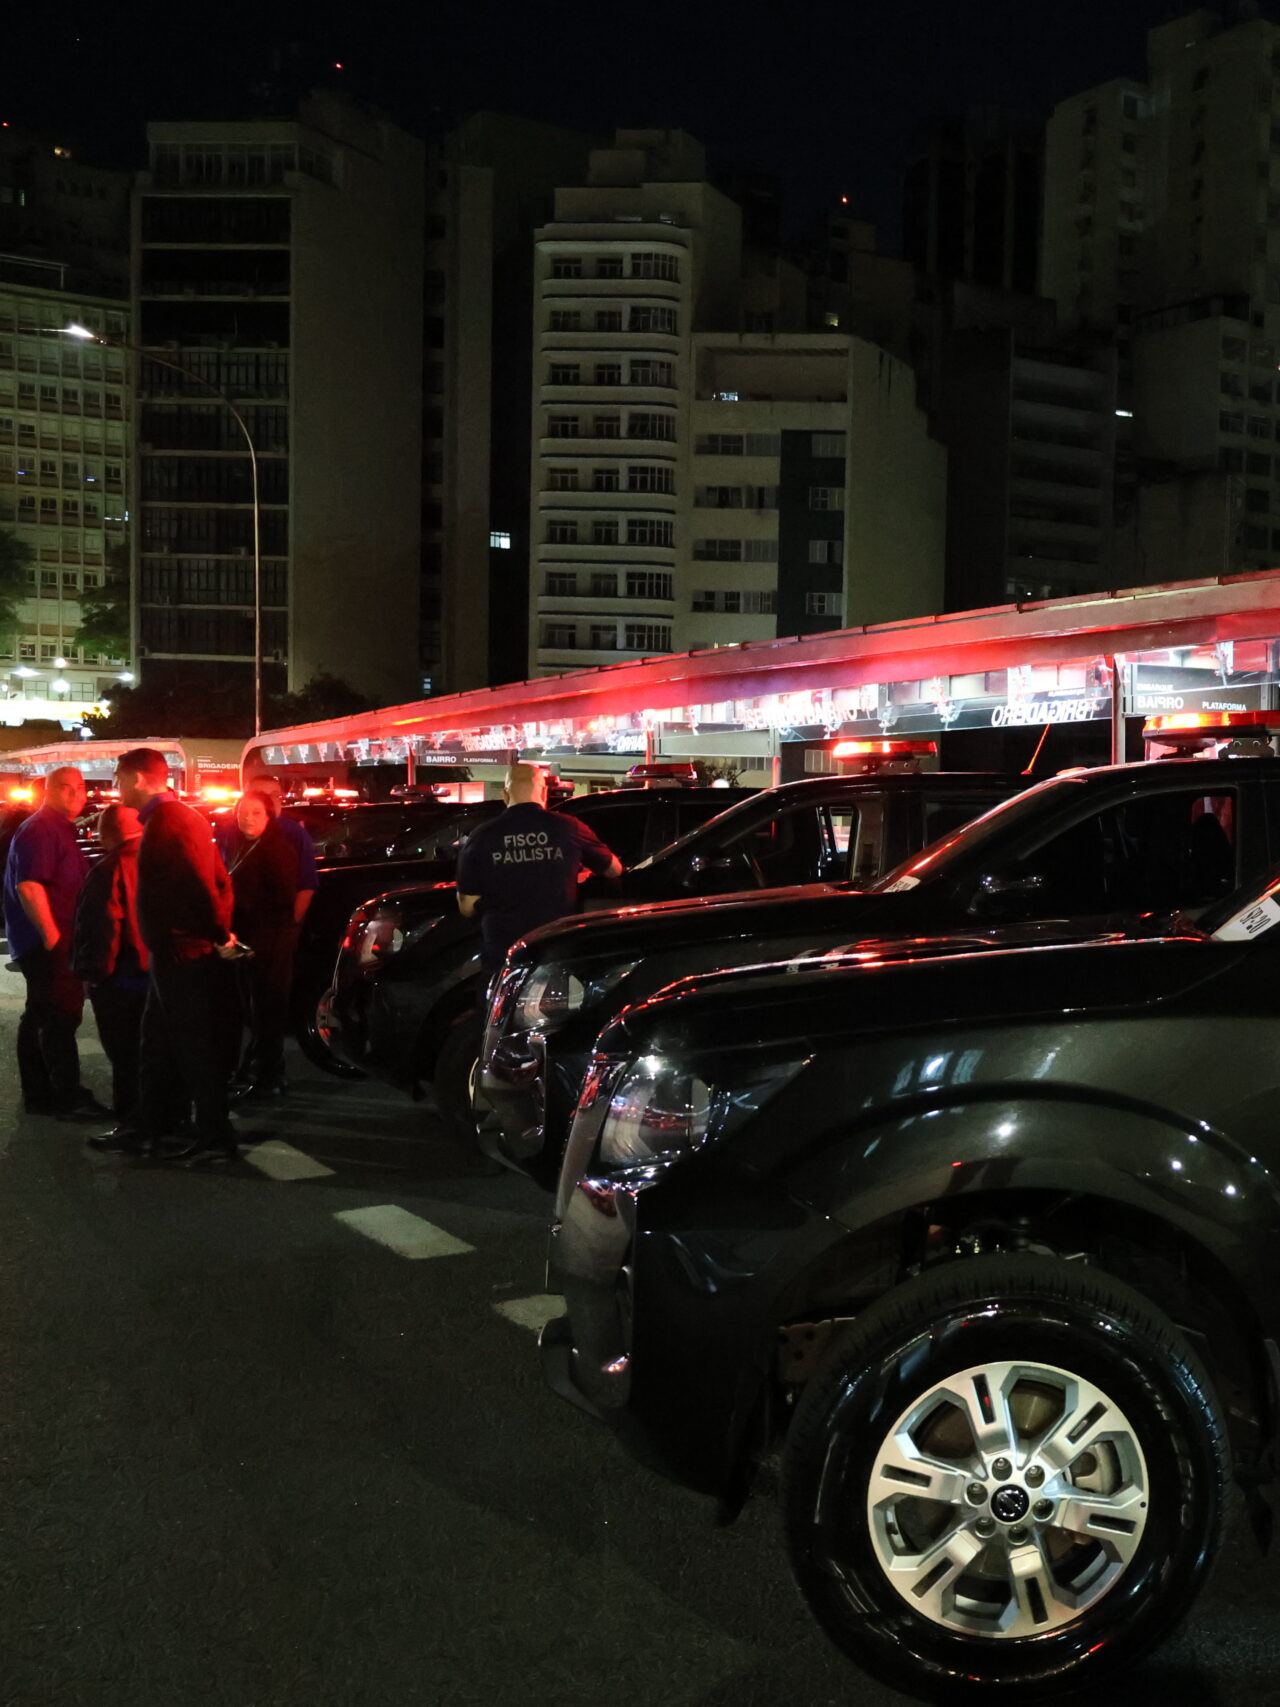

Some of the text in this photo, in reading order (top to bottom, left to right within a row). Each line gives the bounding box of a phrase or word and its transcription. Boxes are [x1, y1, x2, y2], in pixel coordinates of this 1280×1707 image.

[1202, 701, 1247, 712] PLATAFORMA
[426, 755, 457, 764] BAIRRO
[503, 831, 549, 848] FISCO
[492, 847, 564, 865] PAULISTA
